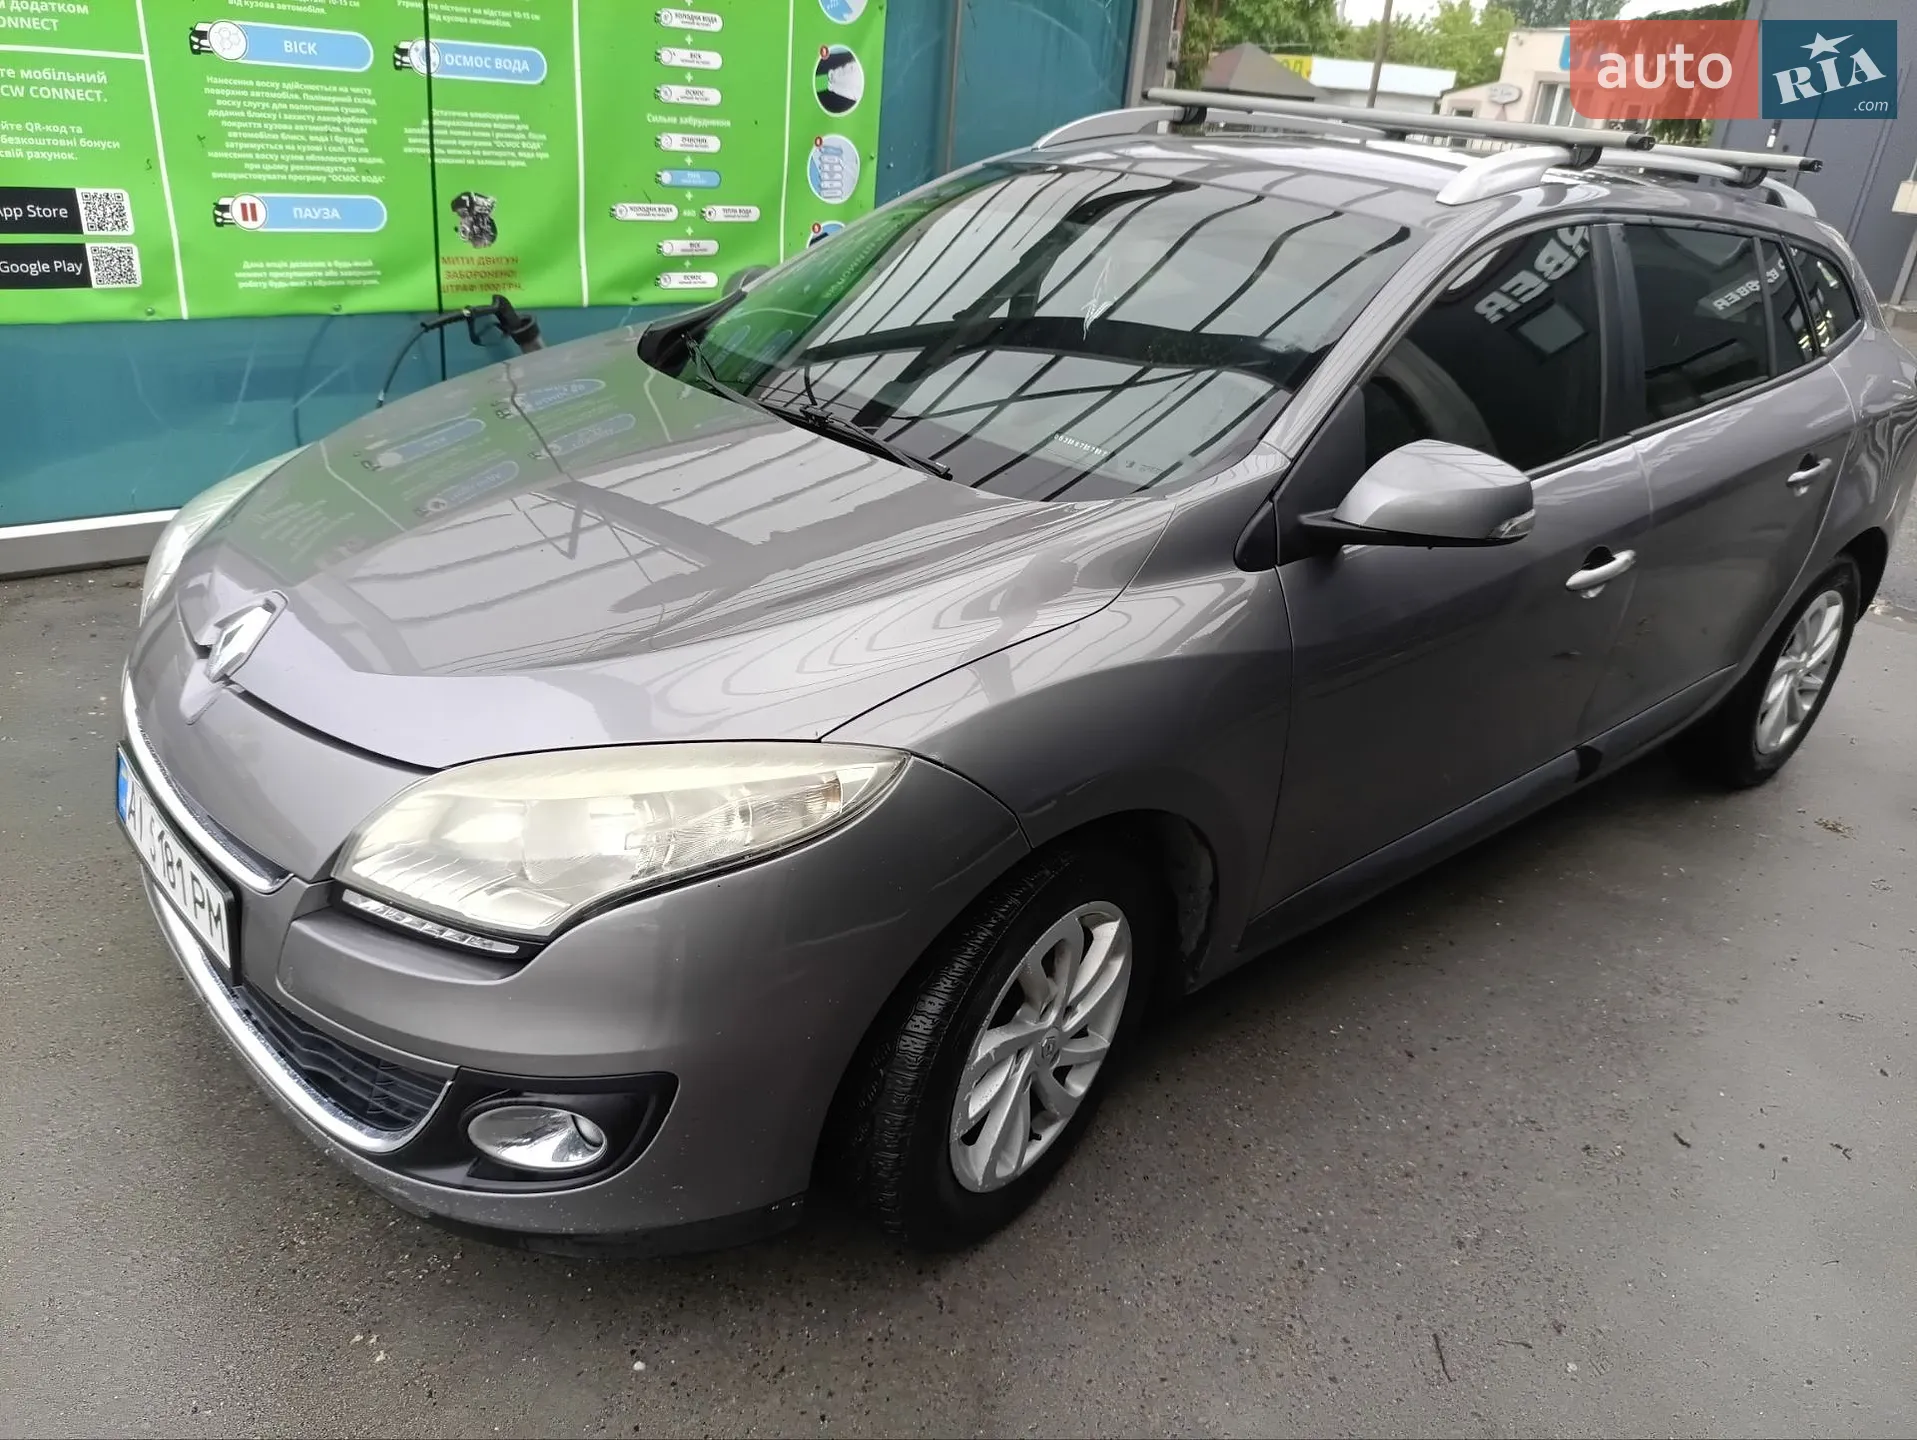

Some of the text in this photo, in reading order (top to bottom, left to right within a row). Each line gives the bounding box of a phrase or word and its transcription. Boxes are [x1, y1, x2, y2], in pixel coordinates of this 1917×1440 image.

[245, 0, 275, 10] кузова
[276, 3, 327, 14] автомобіля.
[283, 40, 318, 56] ВІСК
[444, 54, 530, 74] ОСМОС ВОДА
[20, 67, 108, 85] мобільний
[29, 85, 108, 103] CONNECT.
[25, 121, 67, 135] QR-код
[71, 125, 83, 134] та
[0, 134, 120, 151] безкоштовні бонуси
[26, 150, 78, 161] рахунок.
[0, 204, 69, 220] pp Store
[292, 207, 342, 220] ПАУЗА
[0, 260, 83, 276] Google Play
[127, 780, 144, 843] AI
[190, 870, 226, 952] PM
